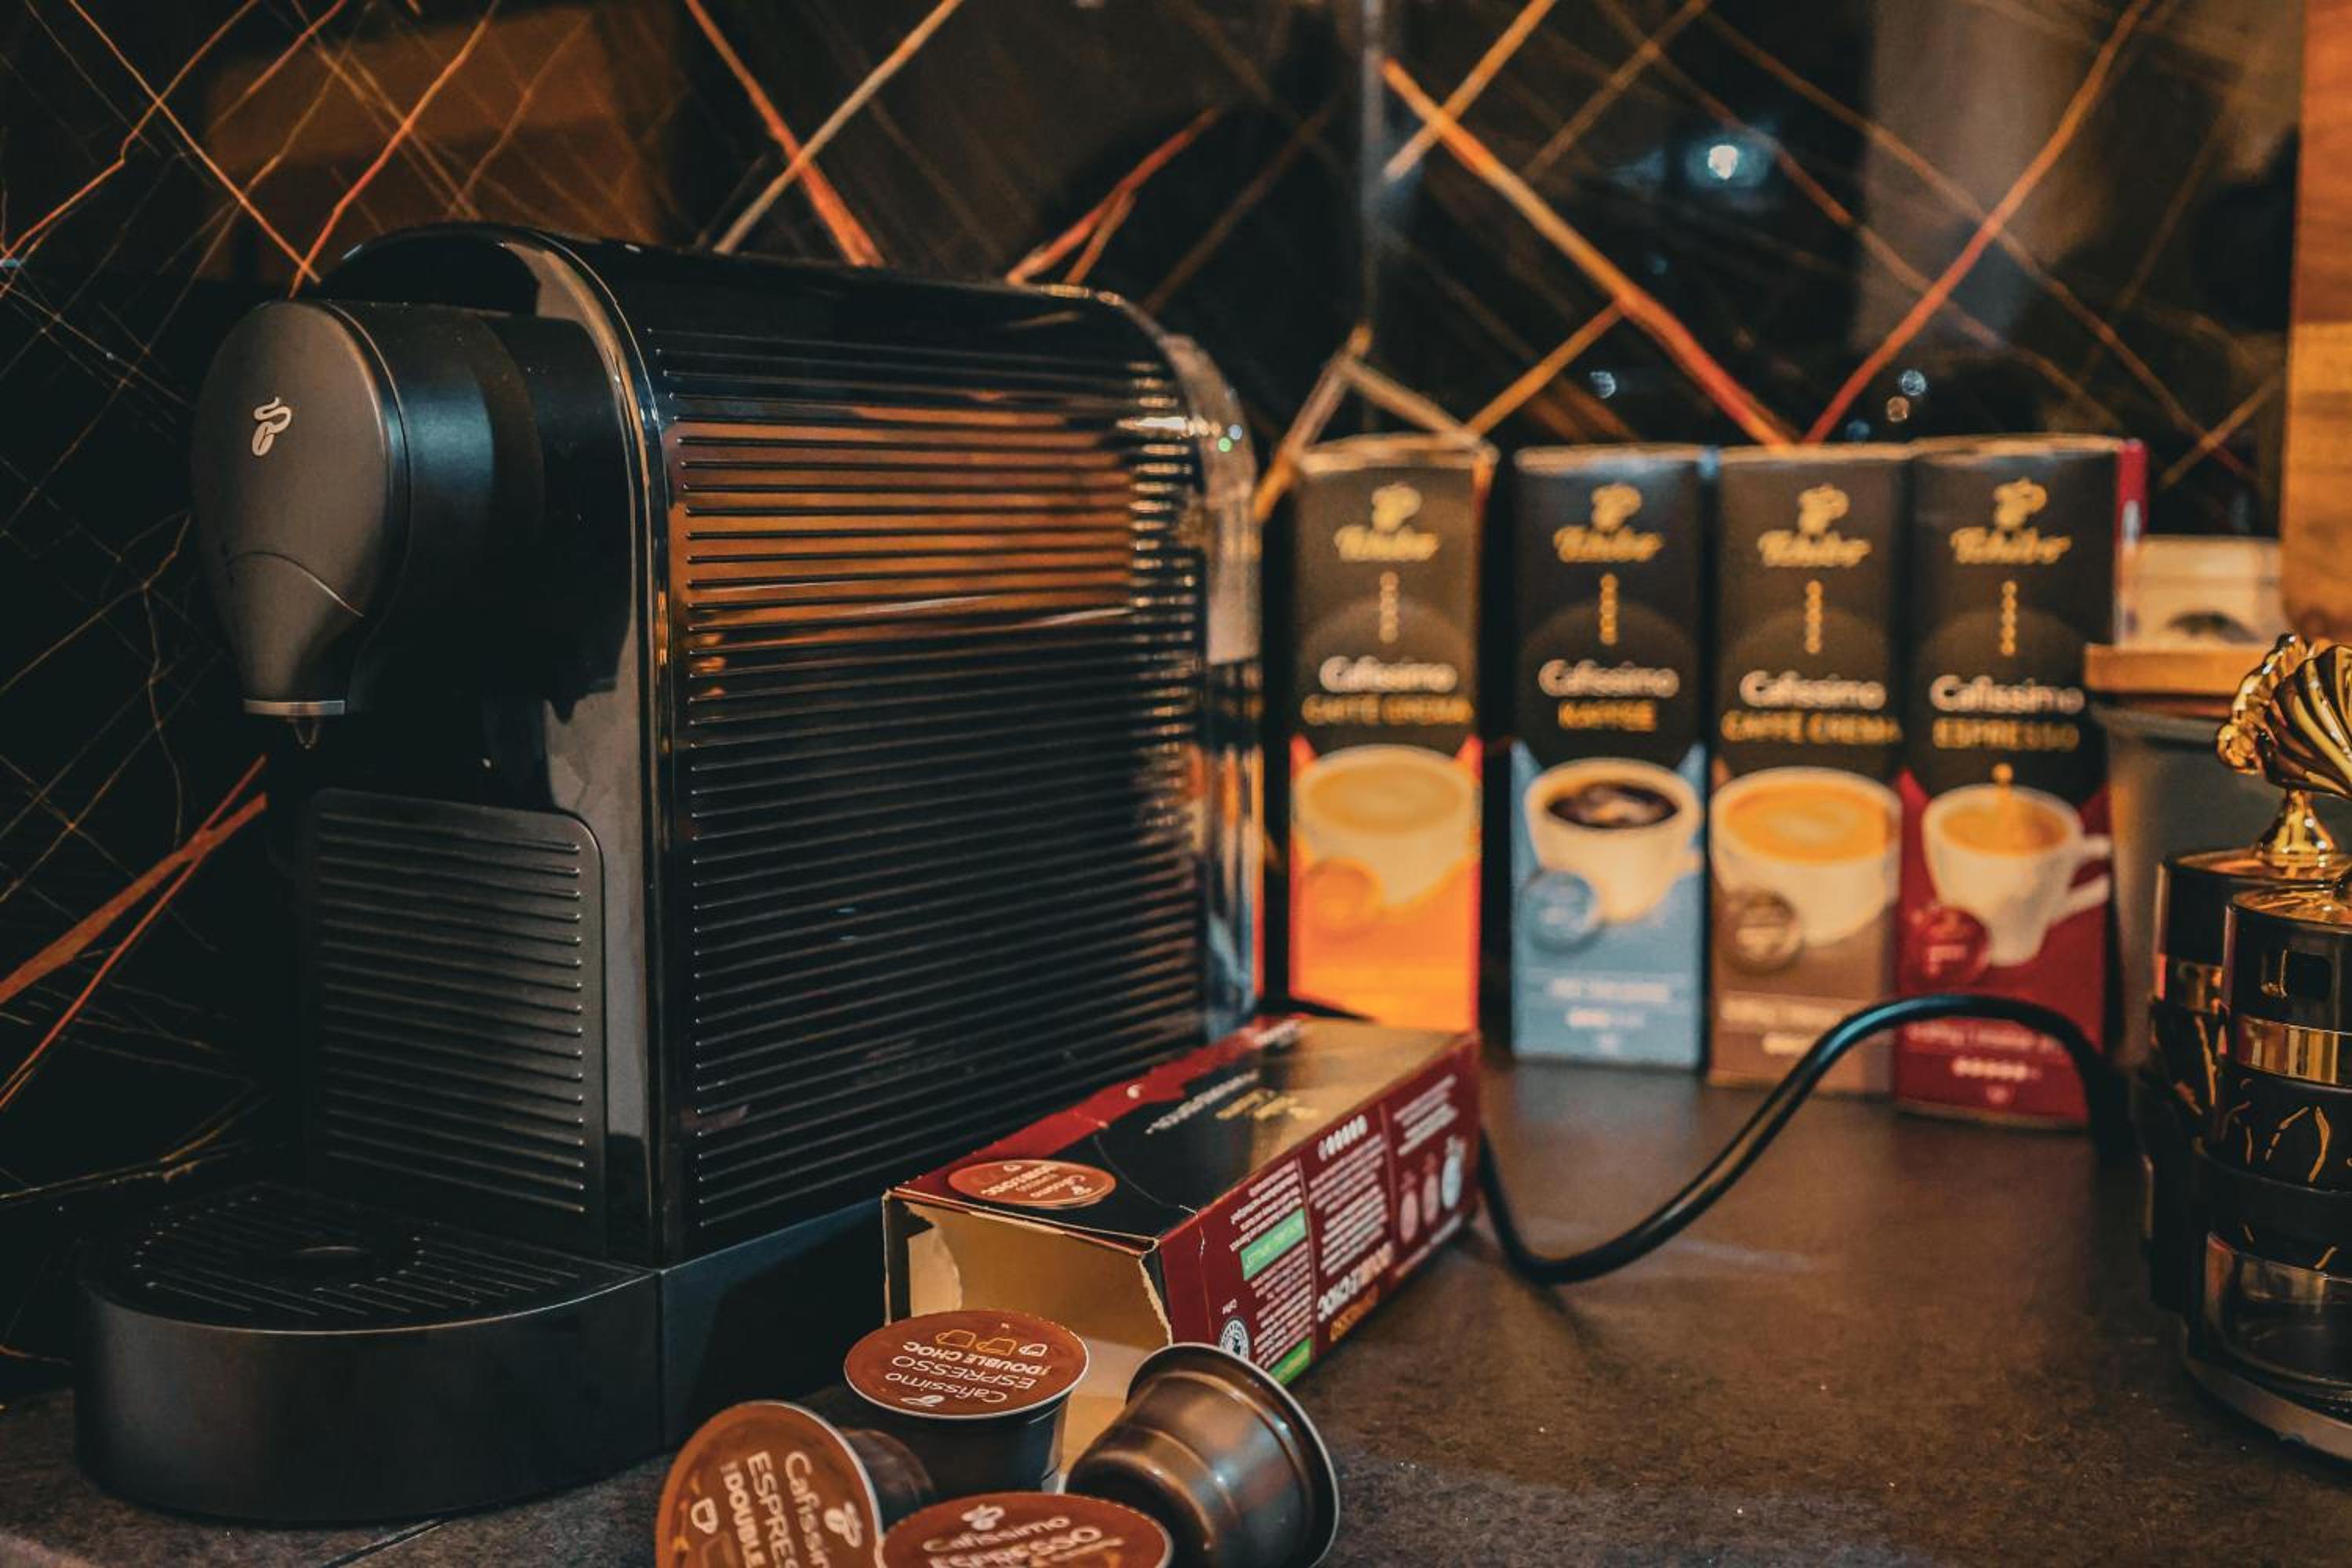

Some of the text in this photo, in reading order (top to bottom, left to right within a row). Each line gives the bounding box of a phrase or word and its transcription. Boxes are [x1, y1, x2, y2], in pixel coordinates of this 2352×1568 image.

[1538, 659, 1680, 699] Cafissimo
[1740, 670, 1886, 710] Cafissimo
[1930, 674, 2085, 714] Cafissimo
[903, 1341, 963, 1360] CHOC
[885, 1373, 1007, 1403] Cafissimo
[891, 1356, 1036, 1389] ESPRESSO
[922, 1515, 1071, 1552] Cafissimo
